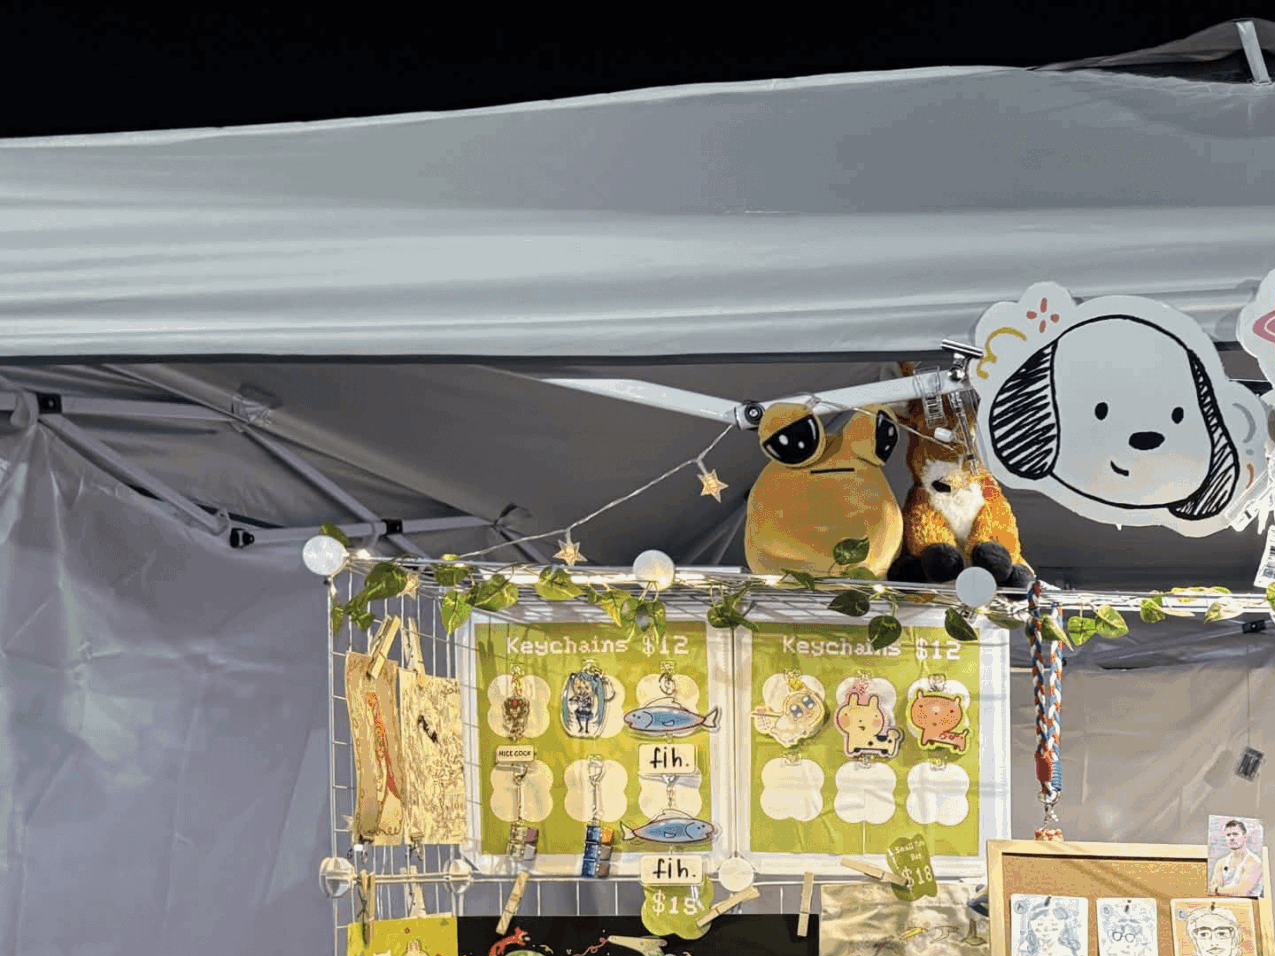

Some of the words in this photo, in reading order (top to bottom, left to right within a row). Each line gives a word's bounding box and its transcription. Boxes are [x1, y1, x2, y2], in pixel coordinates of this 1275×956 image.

[506, 636, 628, 656] Keychains
[642, 635, 689, 657] $12
[782, 636, 902, 657] Keychains
[915, 637, 961, 662] $12
[650, 746, 690, 768] fih.
[652, 857, 697, 879] fih.
[902, 865, 933, 892] $18
